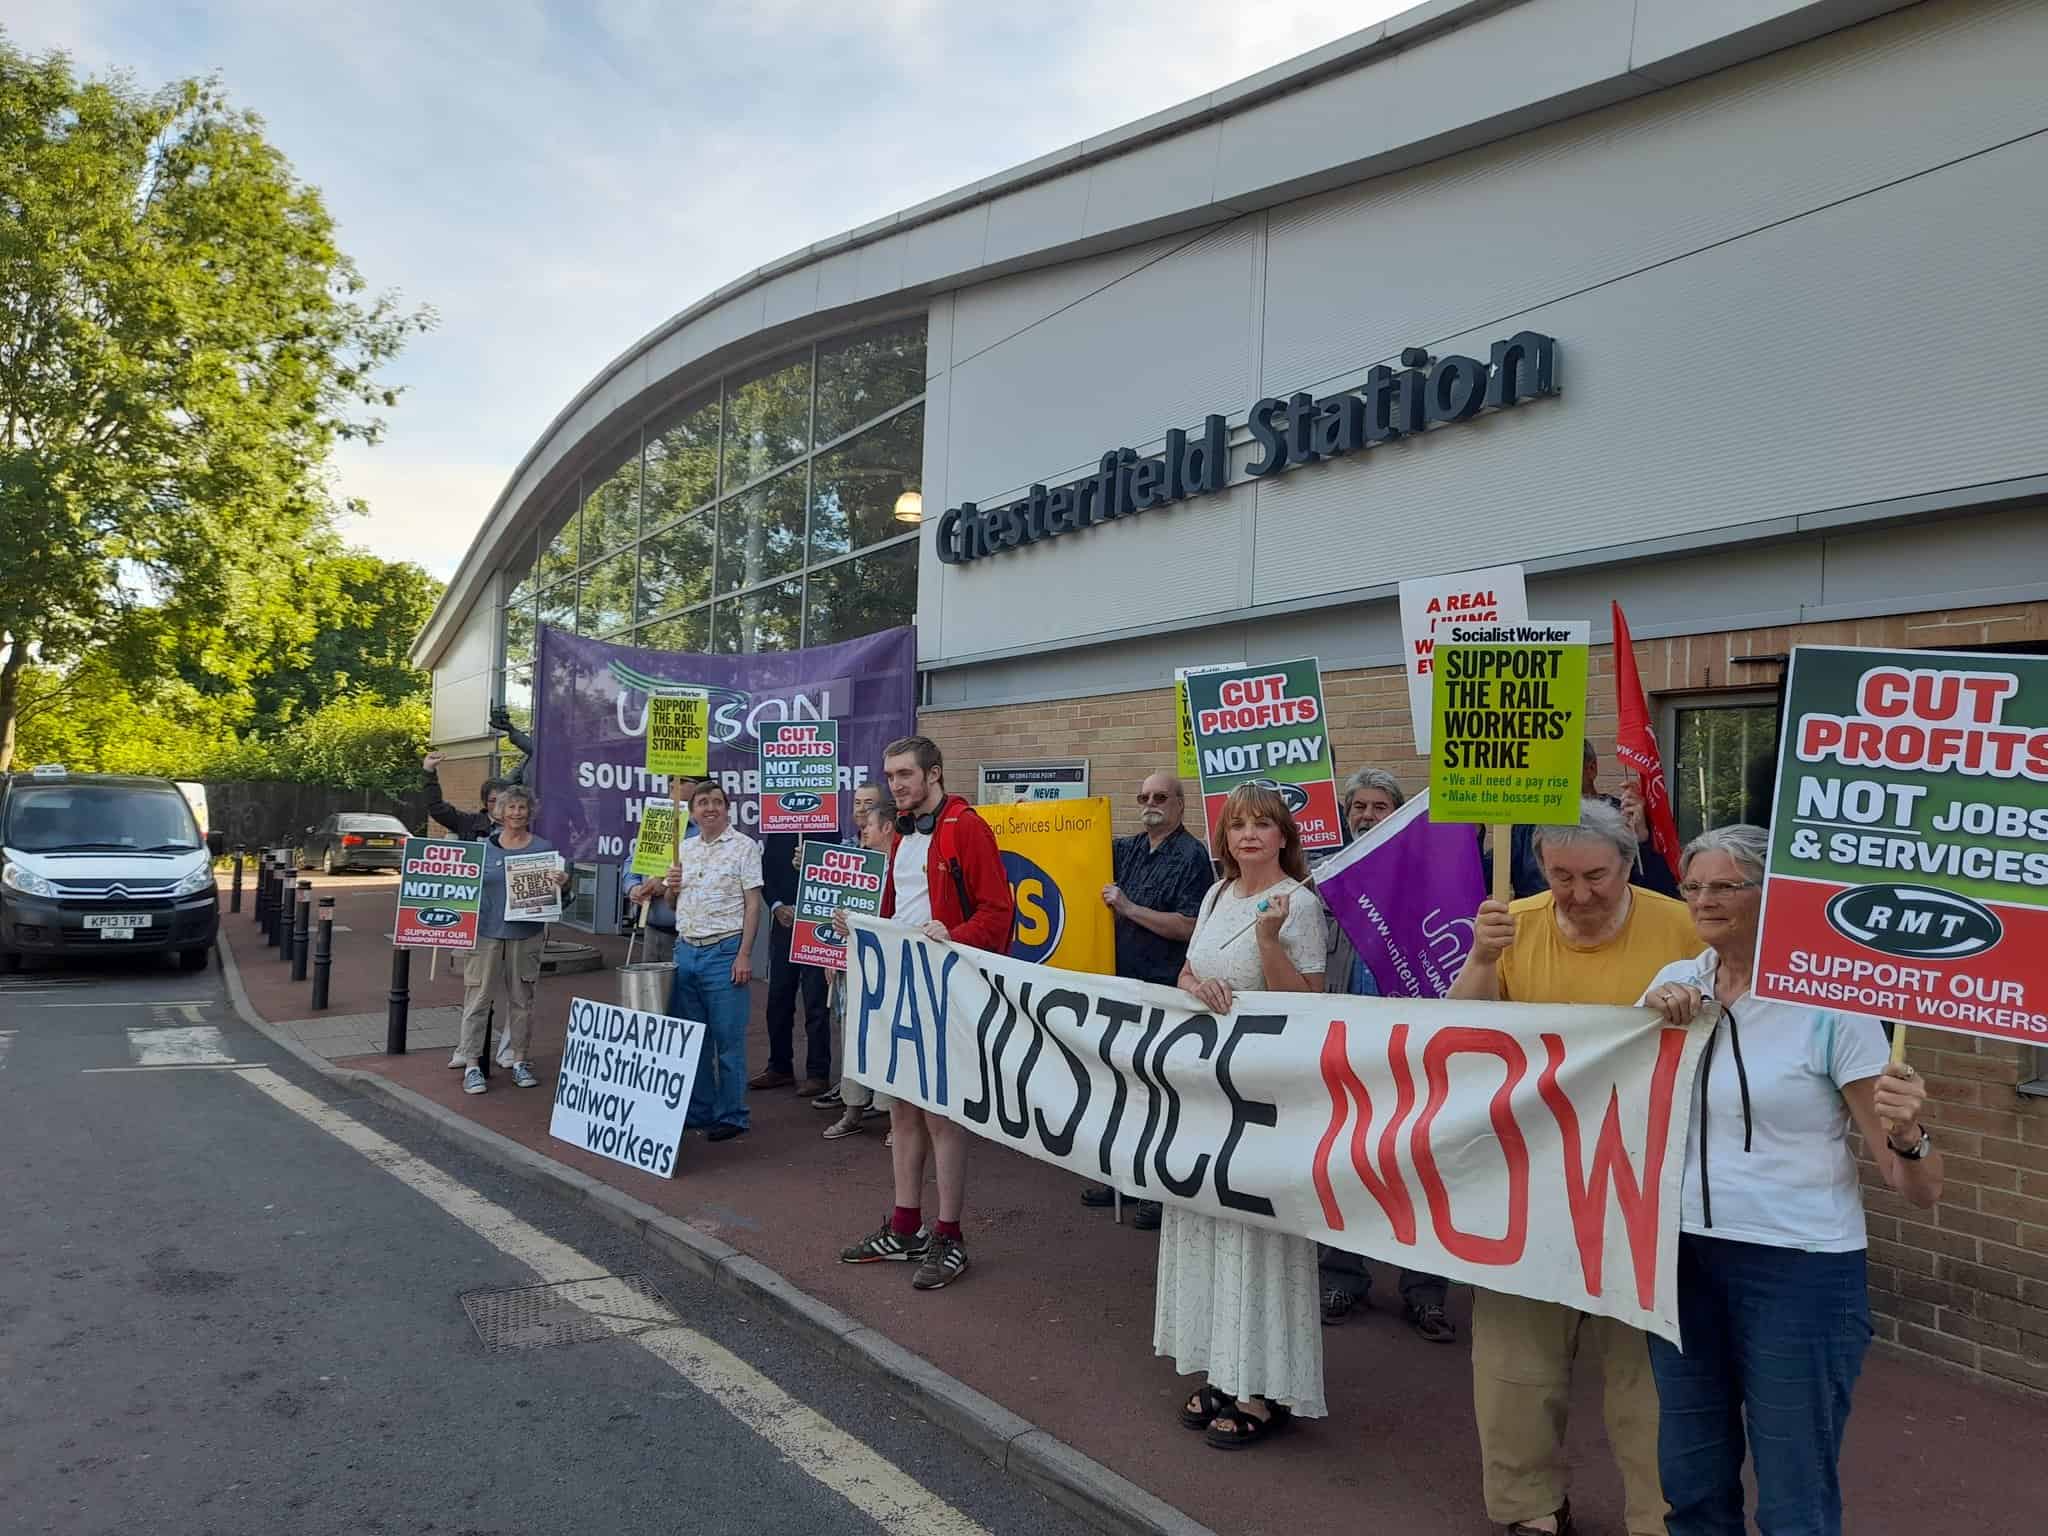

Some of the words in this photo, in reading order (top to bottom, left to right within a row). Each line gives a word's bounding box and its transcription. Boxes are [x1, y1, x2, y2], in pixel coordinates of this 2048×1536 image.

[936, 414, 1226, 565] Chesterfield
[1245, 331, 1561, 476] Station
[1425, 598, 1441, 614] A
[1446, 591, 1497, 611] REAL
[1451, 627, 1516, 643] Socialist
[1516, 627, 1571, 643] Worker
[1446, 650, 1564, 679] SUPPORT
[1222, 675, 1285, 707] CUT
[1445, 680, 1491, 709] THE
[1499, 681, 1554, 710] RAIL
[1863, 672, 2010, 724] CUT
[617, 690, 830, 743] USON
[653, 698, 699, 712] SUPPORT
[1201, 698, 1316, 733] PROFITS
[653, 711, 671, 725] THE
[674, 713, 696, 726] RAIL
[1444, 711, 1572, 740] WORKERS'
[652, 738, 687, 751] STRIKE
[779, 727, 817, 742] CUT
[764, 743, 833, 756] PROFITS
[1203, 744, 1264, 775] NOT
[1267, 736, 1323, 767] PAY
[1444, 741, 1530, 769] STRIKE
[1803, 719, 2048, 776] PROFITS
[578, 761, 670, 794] SOUTH
[765, 761, 801, 775] NOT
[801, 763, 833, 775] JOBS
[765, 777, 775, 788] &
[776, 776, 833, 788] SERVICES
[1449, 773, 1465, 785] We
[1470, 774, 1482, 785] all
[1486, 775, 1512, 786] need
[1516, 776, 1522, 786] a
[1526, 776, 1544, 789] pay
[1547, 776, 1569, 788] rise
[1033, 787, 1060, 799] NEVER
[1449, 789, 1477, 801] Make
[1481, 790, 1498, 802] the
[1502, 791, 1539, 803] bosses
[1543, 793, 1562, 806] pay
[768, 815, 810, 823] SUPPORT
[812, 815, 830, 823] OUR
[1797, 776, 1928, 827] NOT
[1932, 801, 2048, 842] JOBS
[1008, 816, 1050, 835] Services
[1054, 813, 1093, 832] Union
[425, 846, 464, 862] CUT
[598, 835, 623, 856] NO
[639, 841, 665, 856] STRIKE
[408, 861, 478, 877] PROFITS
[824, 851, 865, 871] CUT
[1790, 829, 1821, 861] &
[1829, 832, 2048, 887] SERVICES
[806, 866, 879, 889] PROFITS
[404, 881, 442, 898] NOT
[445, 884, 478, 900] PAY
[804, 885, 842, 905] NOT
[842, 895, 876, 910] JOBS
[91, 916, 119, 927] KP13
[122, 915, 145, 926] TRX
[1865, 904, 1966, 939] RMT
[404, 928, 447, 938] SUPPORT
[447, 931, 468, 940] OUR
[801, 944, 844, 958] SUPPORT
[1788, 950, 1941, 993] SUPPORT
[1949, 973, 2025, 1008] OUR
[1764, 973, 1911, 1011] TRANSPORT
[1916, 997, 2048, 1034] WORKERS
[568, 999, 695, 1058] SOLIDARITY
[563, 1037, 600, 1079] With
[600, 1047, 686, 1110] Striking
[555, 1071, 636, 1127] Railway
[852, 928, 961, 1107] PAY
[963, 966, 1288, 1218] JUSTICE
[1312, 1020, 1687, 1313] NOW
[586, 1121, 673, 1174] workers
